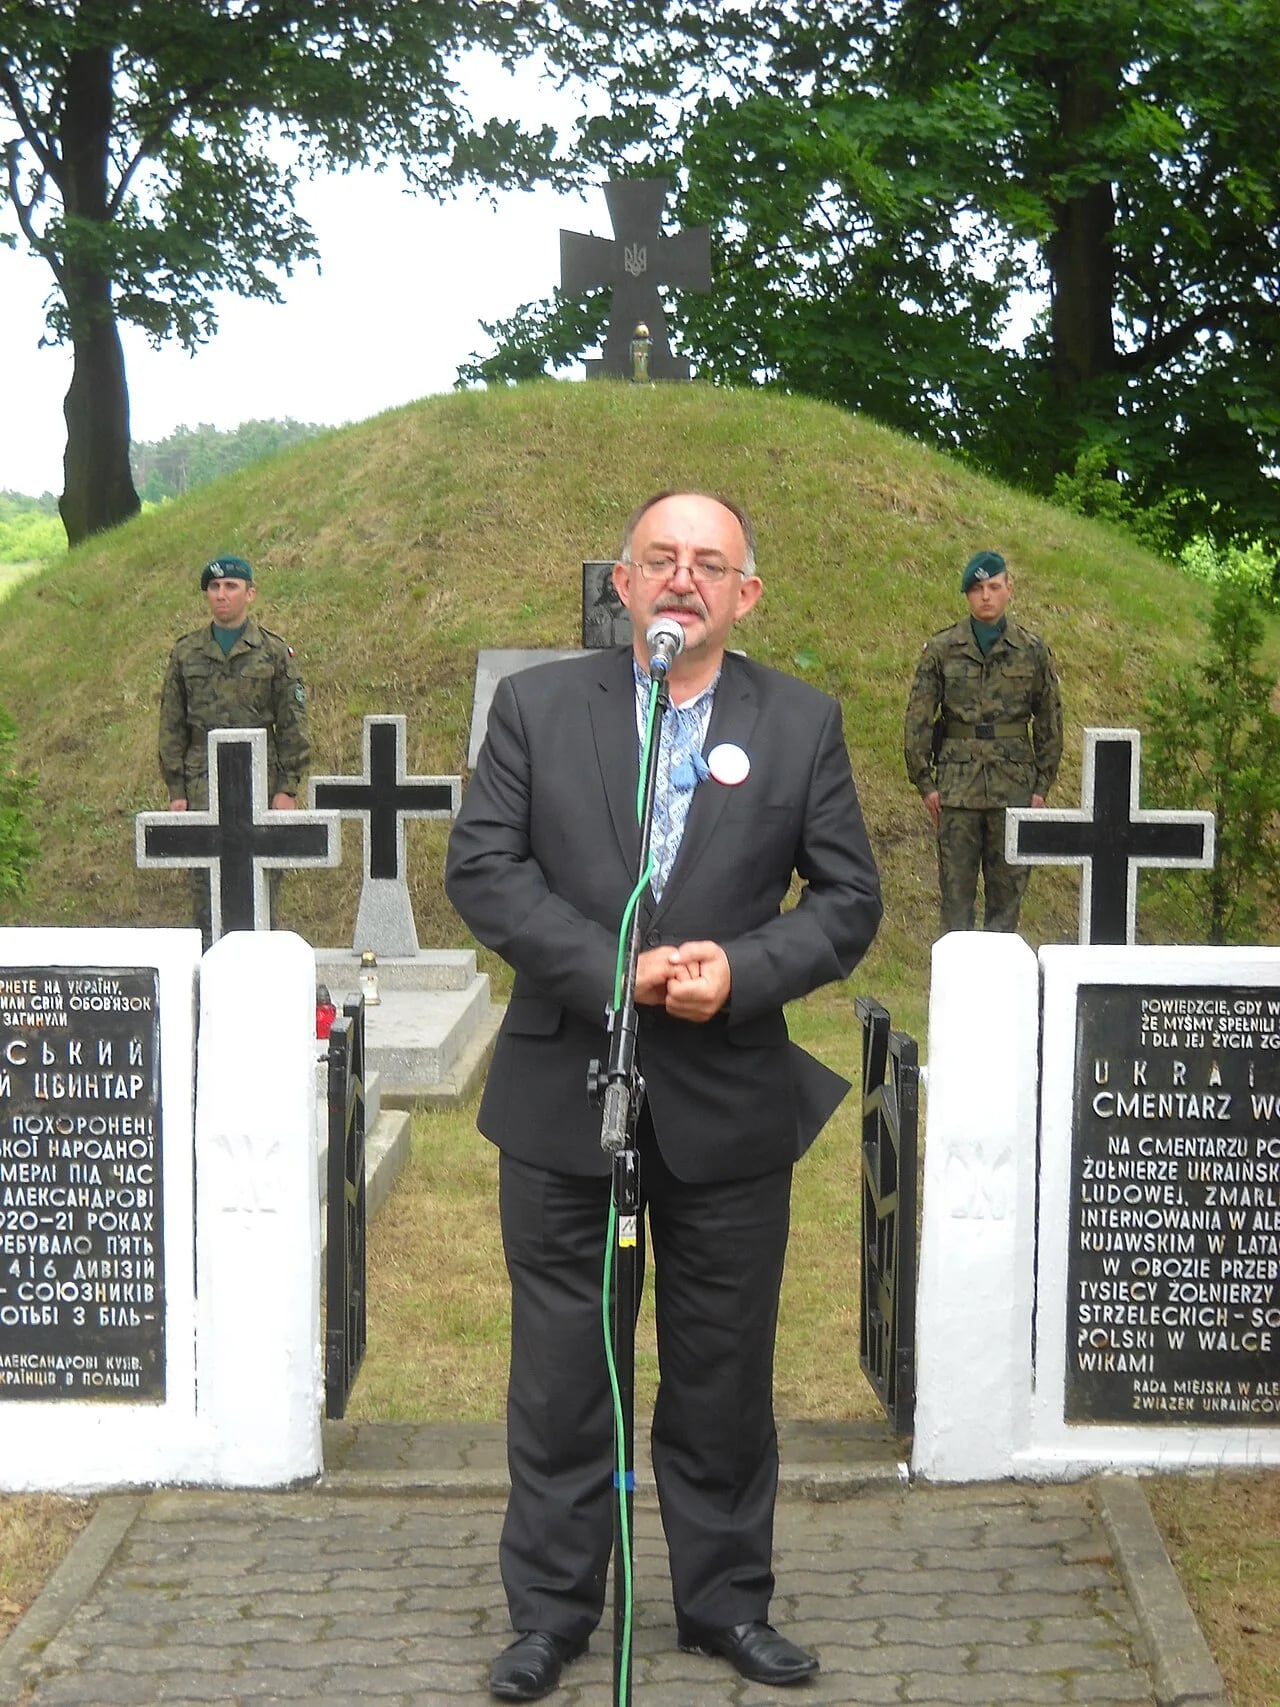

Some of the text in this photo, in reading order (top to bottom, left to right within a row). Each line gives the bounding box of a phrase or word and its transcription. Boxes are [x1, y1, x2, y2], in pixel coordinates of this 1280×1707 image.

[44, 980, 61, 994] НА
[31, 994, 63, 1011] СВІЙ
[1142, 999, 1231, 1016] POWIEDZCIE,
[1234, 1000, 1262, 1016] GDY
[3, 1012, 68, 1027] ЗАГИНУЛИ
[1142, 1014, 1158, 1031] ŻE
[1164, 1013, 1214, 1032] MYŚMY
[1219, 1017, 1275, 1032] SPEŁNILI
[1141, 1032, 1146, 1046] I
[1153, 1034, 1178, 1048] DLA
[1185, 1034, 1205, 1048] JEJ
[1212, 1031, 1253, 1049] ŻYCIA
[34, 1072, 144, 1100] ЦВИНТАР
[1093, 1092, 1280, 1120] CMENTARZ W
[13, 1116, 153, 1135] ПОХОРОНЕНІ
[0, 1136, 154, 1160] КОЇ НАРОДНОЇ
[1108, 1137, 1130, 1156] NA
[1139, 1137, 1248, 1158] CMENTARZU
[69, 1164, 103, 1185] ПІД
[113, 1164, 153, 1185] ЧАС
[1082, 1155, 1179, 1180] ŻOŁNIERZE
[4, 1187, 154, 1209] АЛЕКСАНДРОВІ
[1081, 1184, 1189, 1207] LUDOWEJ,
[88, 1212, 154, 1232] РОКАХ
[1081, 1209, 1221, 1230] INTERNOWANIA
[1228, 1211, 1246, 1231] W
[0, 1234, 154, 1255] ЕБУВАЛО П'ЯТЬ
[1080, 1232, 1280, 1255] KUJAWSKIM W LATA
[9, 1259, 21, 1278] 4
[43, 1260, 57, 1279] 6
[73, 1258, 155, 1280] ДИВІЗІЙ
[1102, 1257, 1280, 1279] W OBOZIE PRZEB
[18, 1281, 155, 1303] СОЮЗНИКІВ
[1079, 1279, 1274, 1304] TYSIĘCY ŻOŁNIERZY
[0, 1305, 59, 1326] ОТЬБІ
[72, 1306, 86, 1326] З
[1079, 1304, 1228, 1327] STRZELECKICH
[1077, 1328, 1272, 1352] POLSKI W WALCE
[1077, 1353, 1154, 1372] WIKAMI
[66, 1373, 73, 1386] В
[83, 1373, 140, 1388] ПОЛЬЩІ
[1134, 1379, 1167, 1394] RADA
[1237, 1381, 1250, 1396] W
